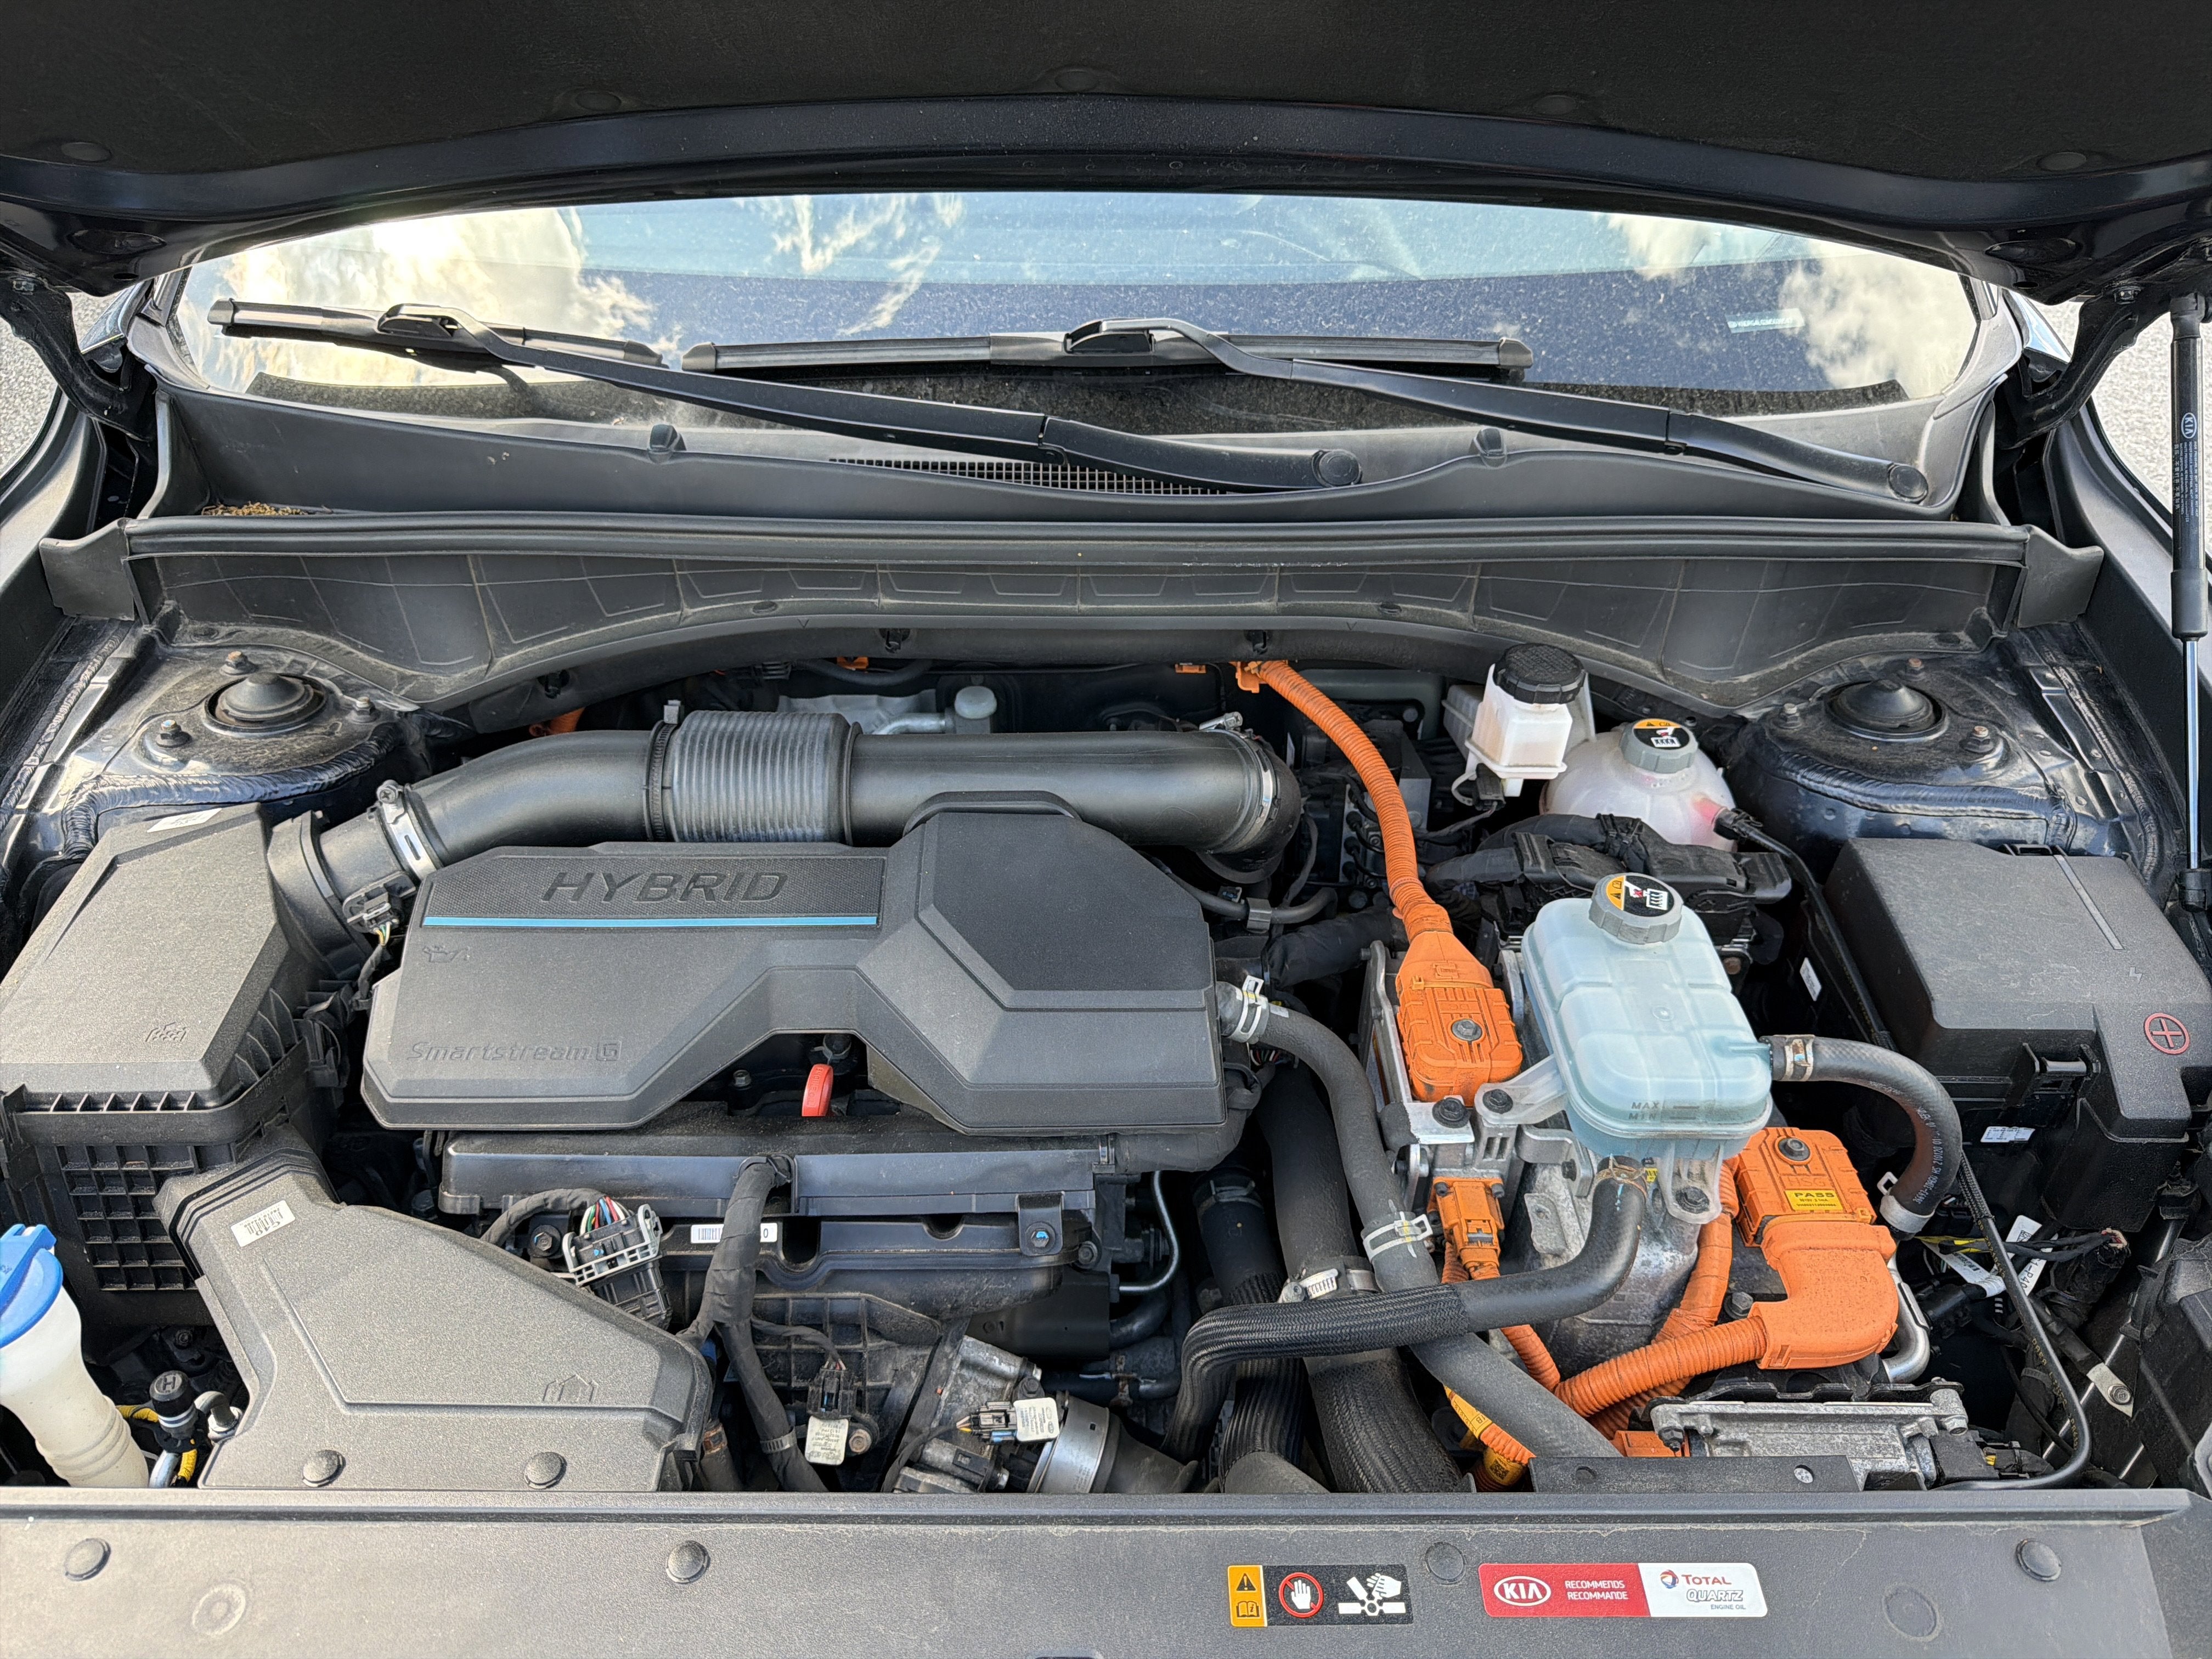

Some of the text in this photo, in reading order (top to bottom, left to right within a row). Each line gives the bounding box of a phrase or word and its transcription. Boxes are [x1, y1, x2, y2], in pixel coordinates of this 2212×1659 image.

[541, 872, 788, 902] HYBRID
[407, 1042, 592, 1062] Smartstream
[1788, 1177, 1826, 1187] HSG
[162, 1375, 177, 1391] H
[1565, 1580, 1626, 1589] RECOMMENDS
[1681, 1574, 1732, 1585] TOTAL
[1567, 1591, 1629, 1600] RECOMMANDE
[1686, 1588, 1743, 1602] QUARTZ
